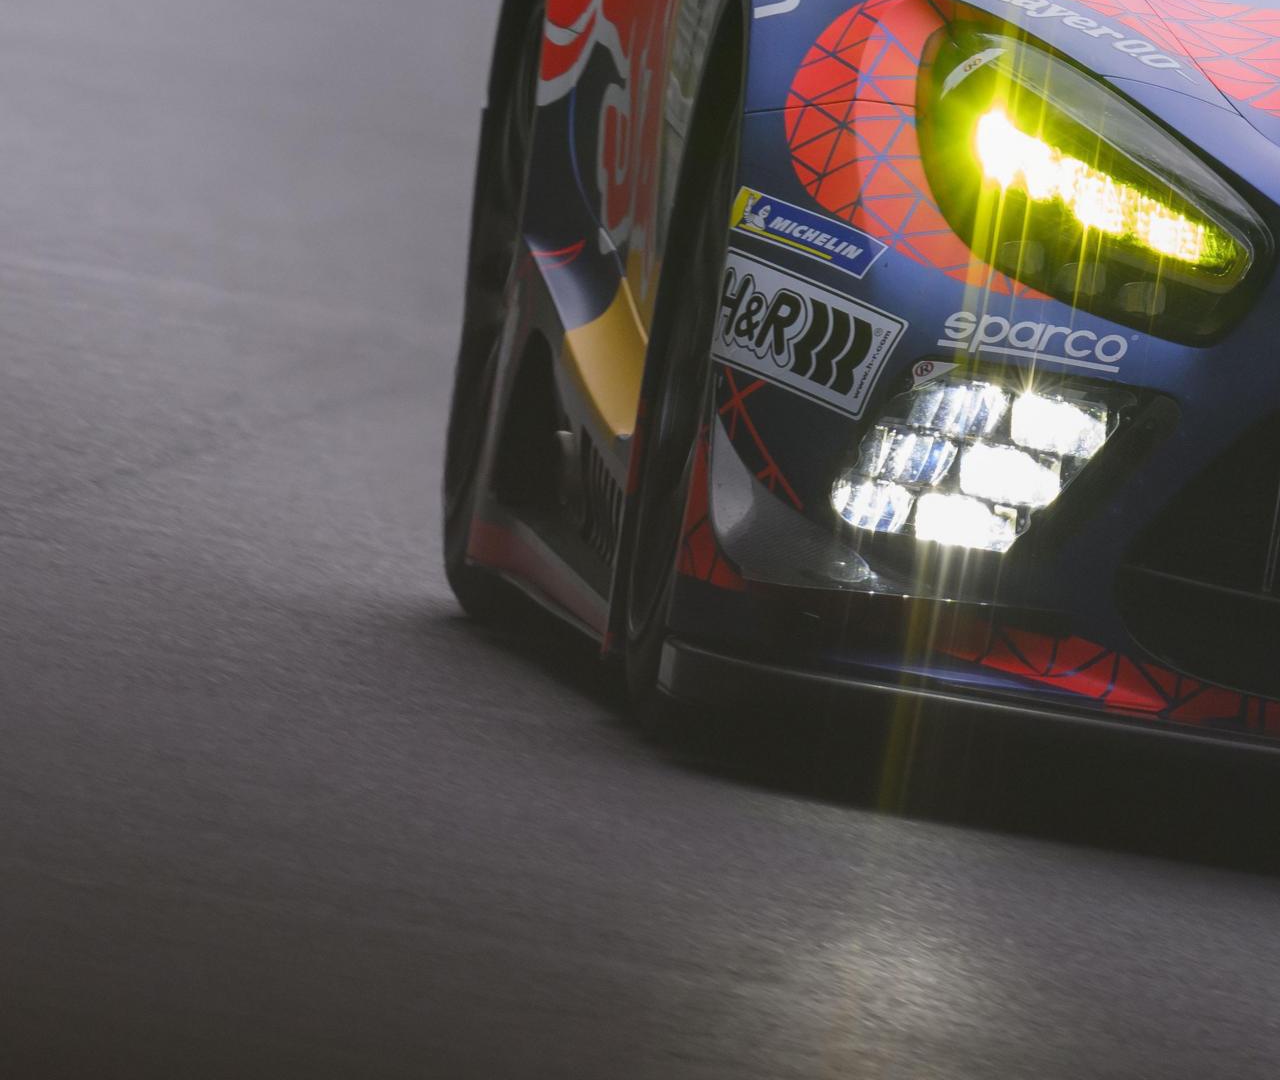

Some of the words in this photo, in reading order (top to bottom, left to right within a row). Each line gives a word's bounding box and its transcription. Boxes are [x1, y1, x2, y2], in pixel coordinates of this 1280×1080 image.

[768, 216, 864, 260] MICHELIN
[721, 267, 803, 358] H&R
[944, 311, 1129, 363] sparco
